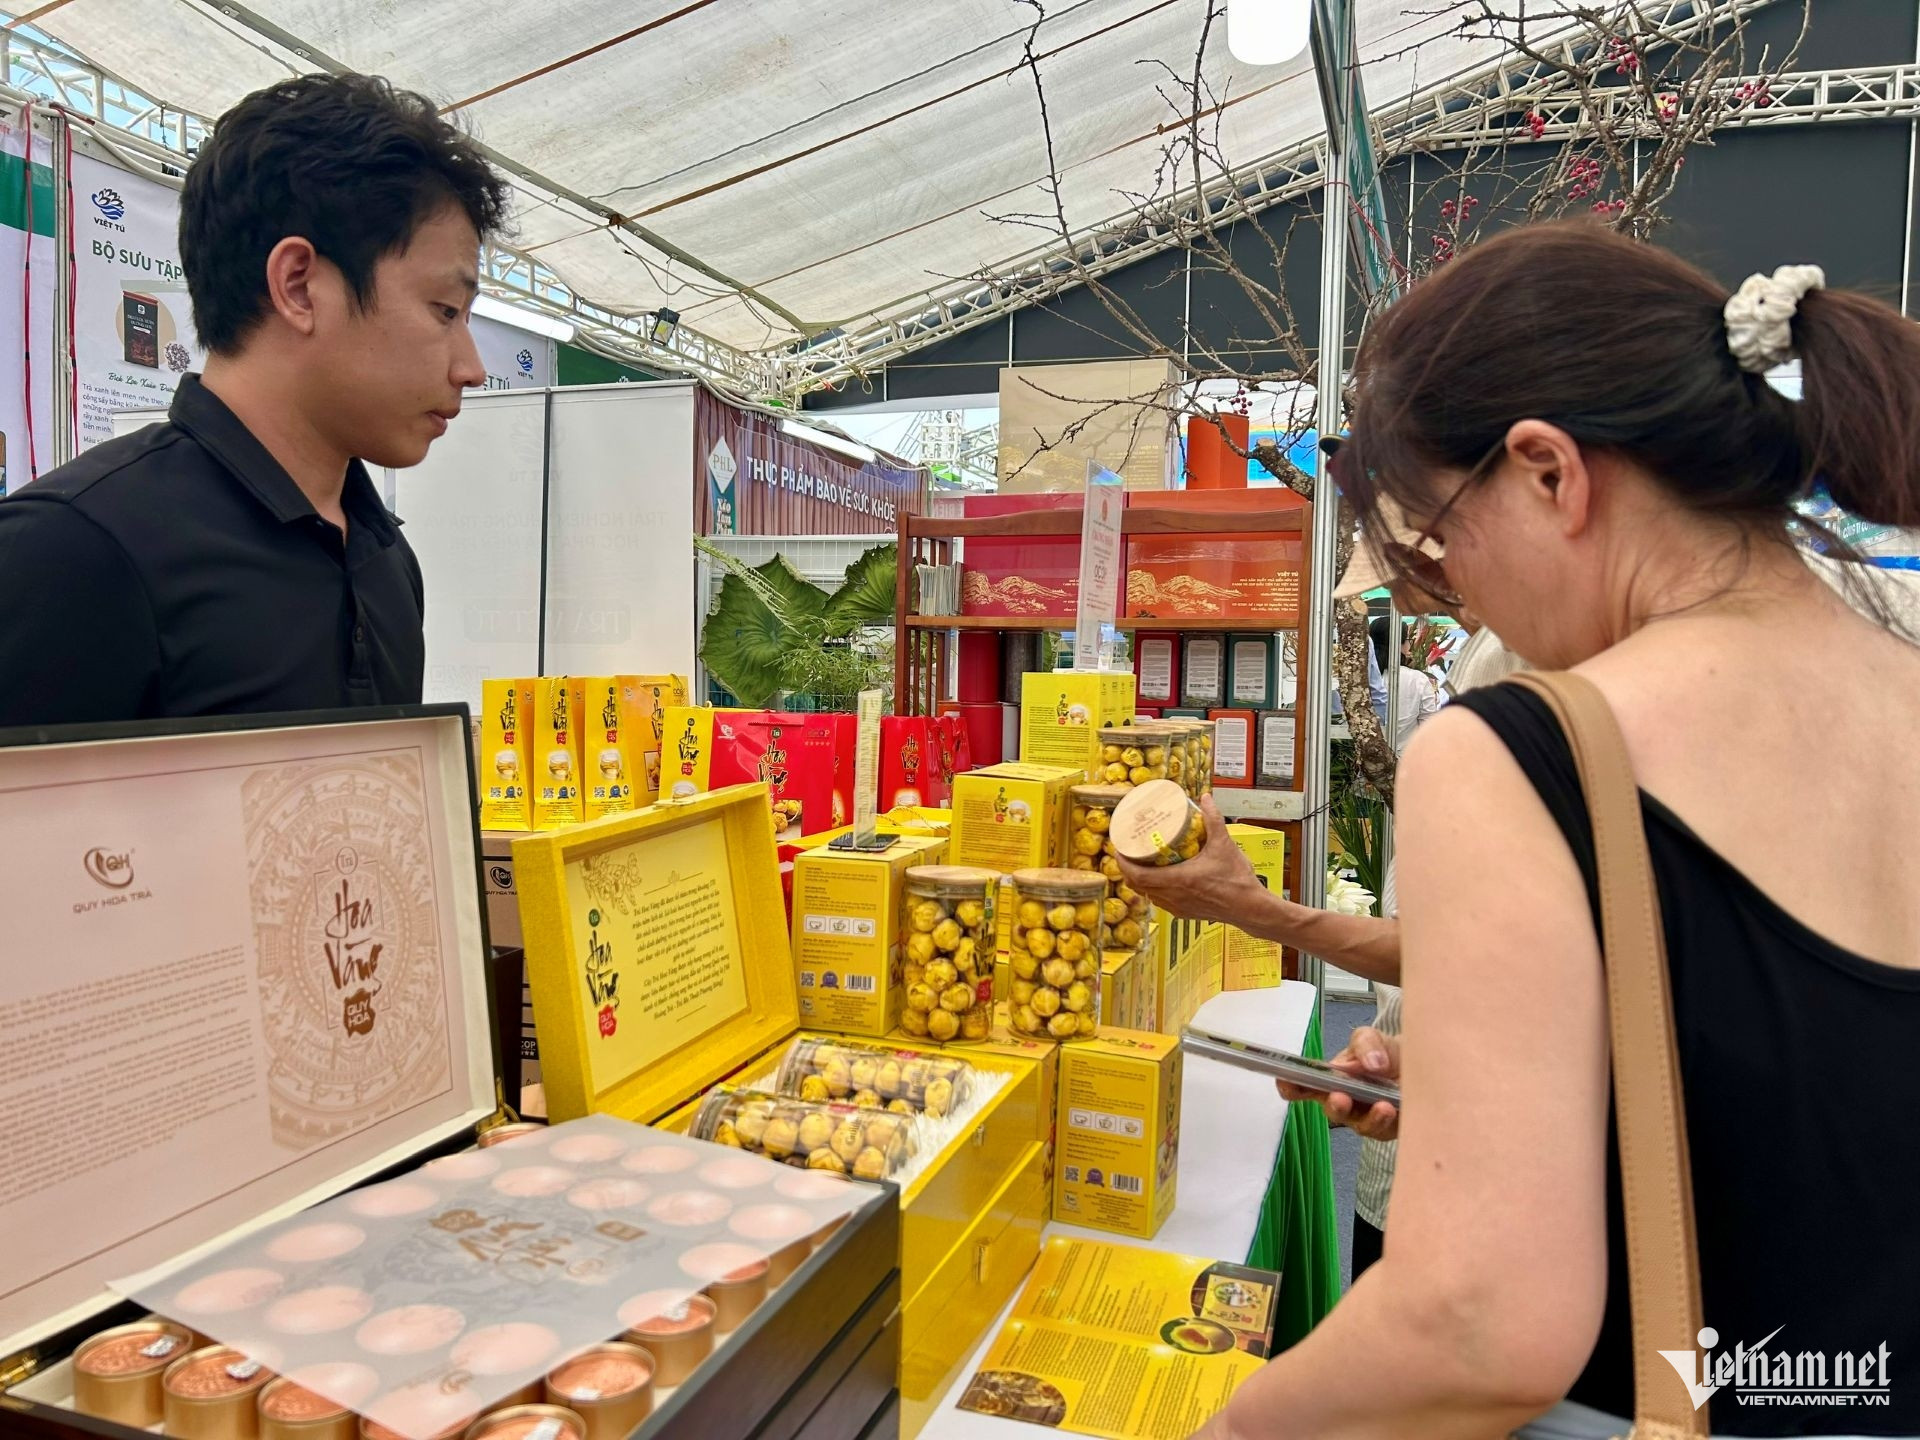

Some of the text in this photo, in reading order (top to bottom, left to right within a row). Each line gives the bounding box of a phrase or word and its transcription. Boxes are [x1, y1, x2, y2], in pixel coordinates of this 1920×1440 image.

[94, 217, 125, 232] VIỆT TÚ
[92, 240, 182, 282] BỘ SƯU TẬP
[746, 456, 778, 488] THỰC
[781, 464, 813, 496] PHẨM
[838, 483, 852, 512] VỆ
[853, 490, 870, 514] SỨC
[73, 901, 98, 913] QUY
[102, 895, 128, 907] HOA
[325, 879, 373, 939] Hoa
